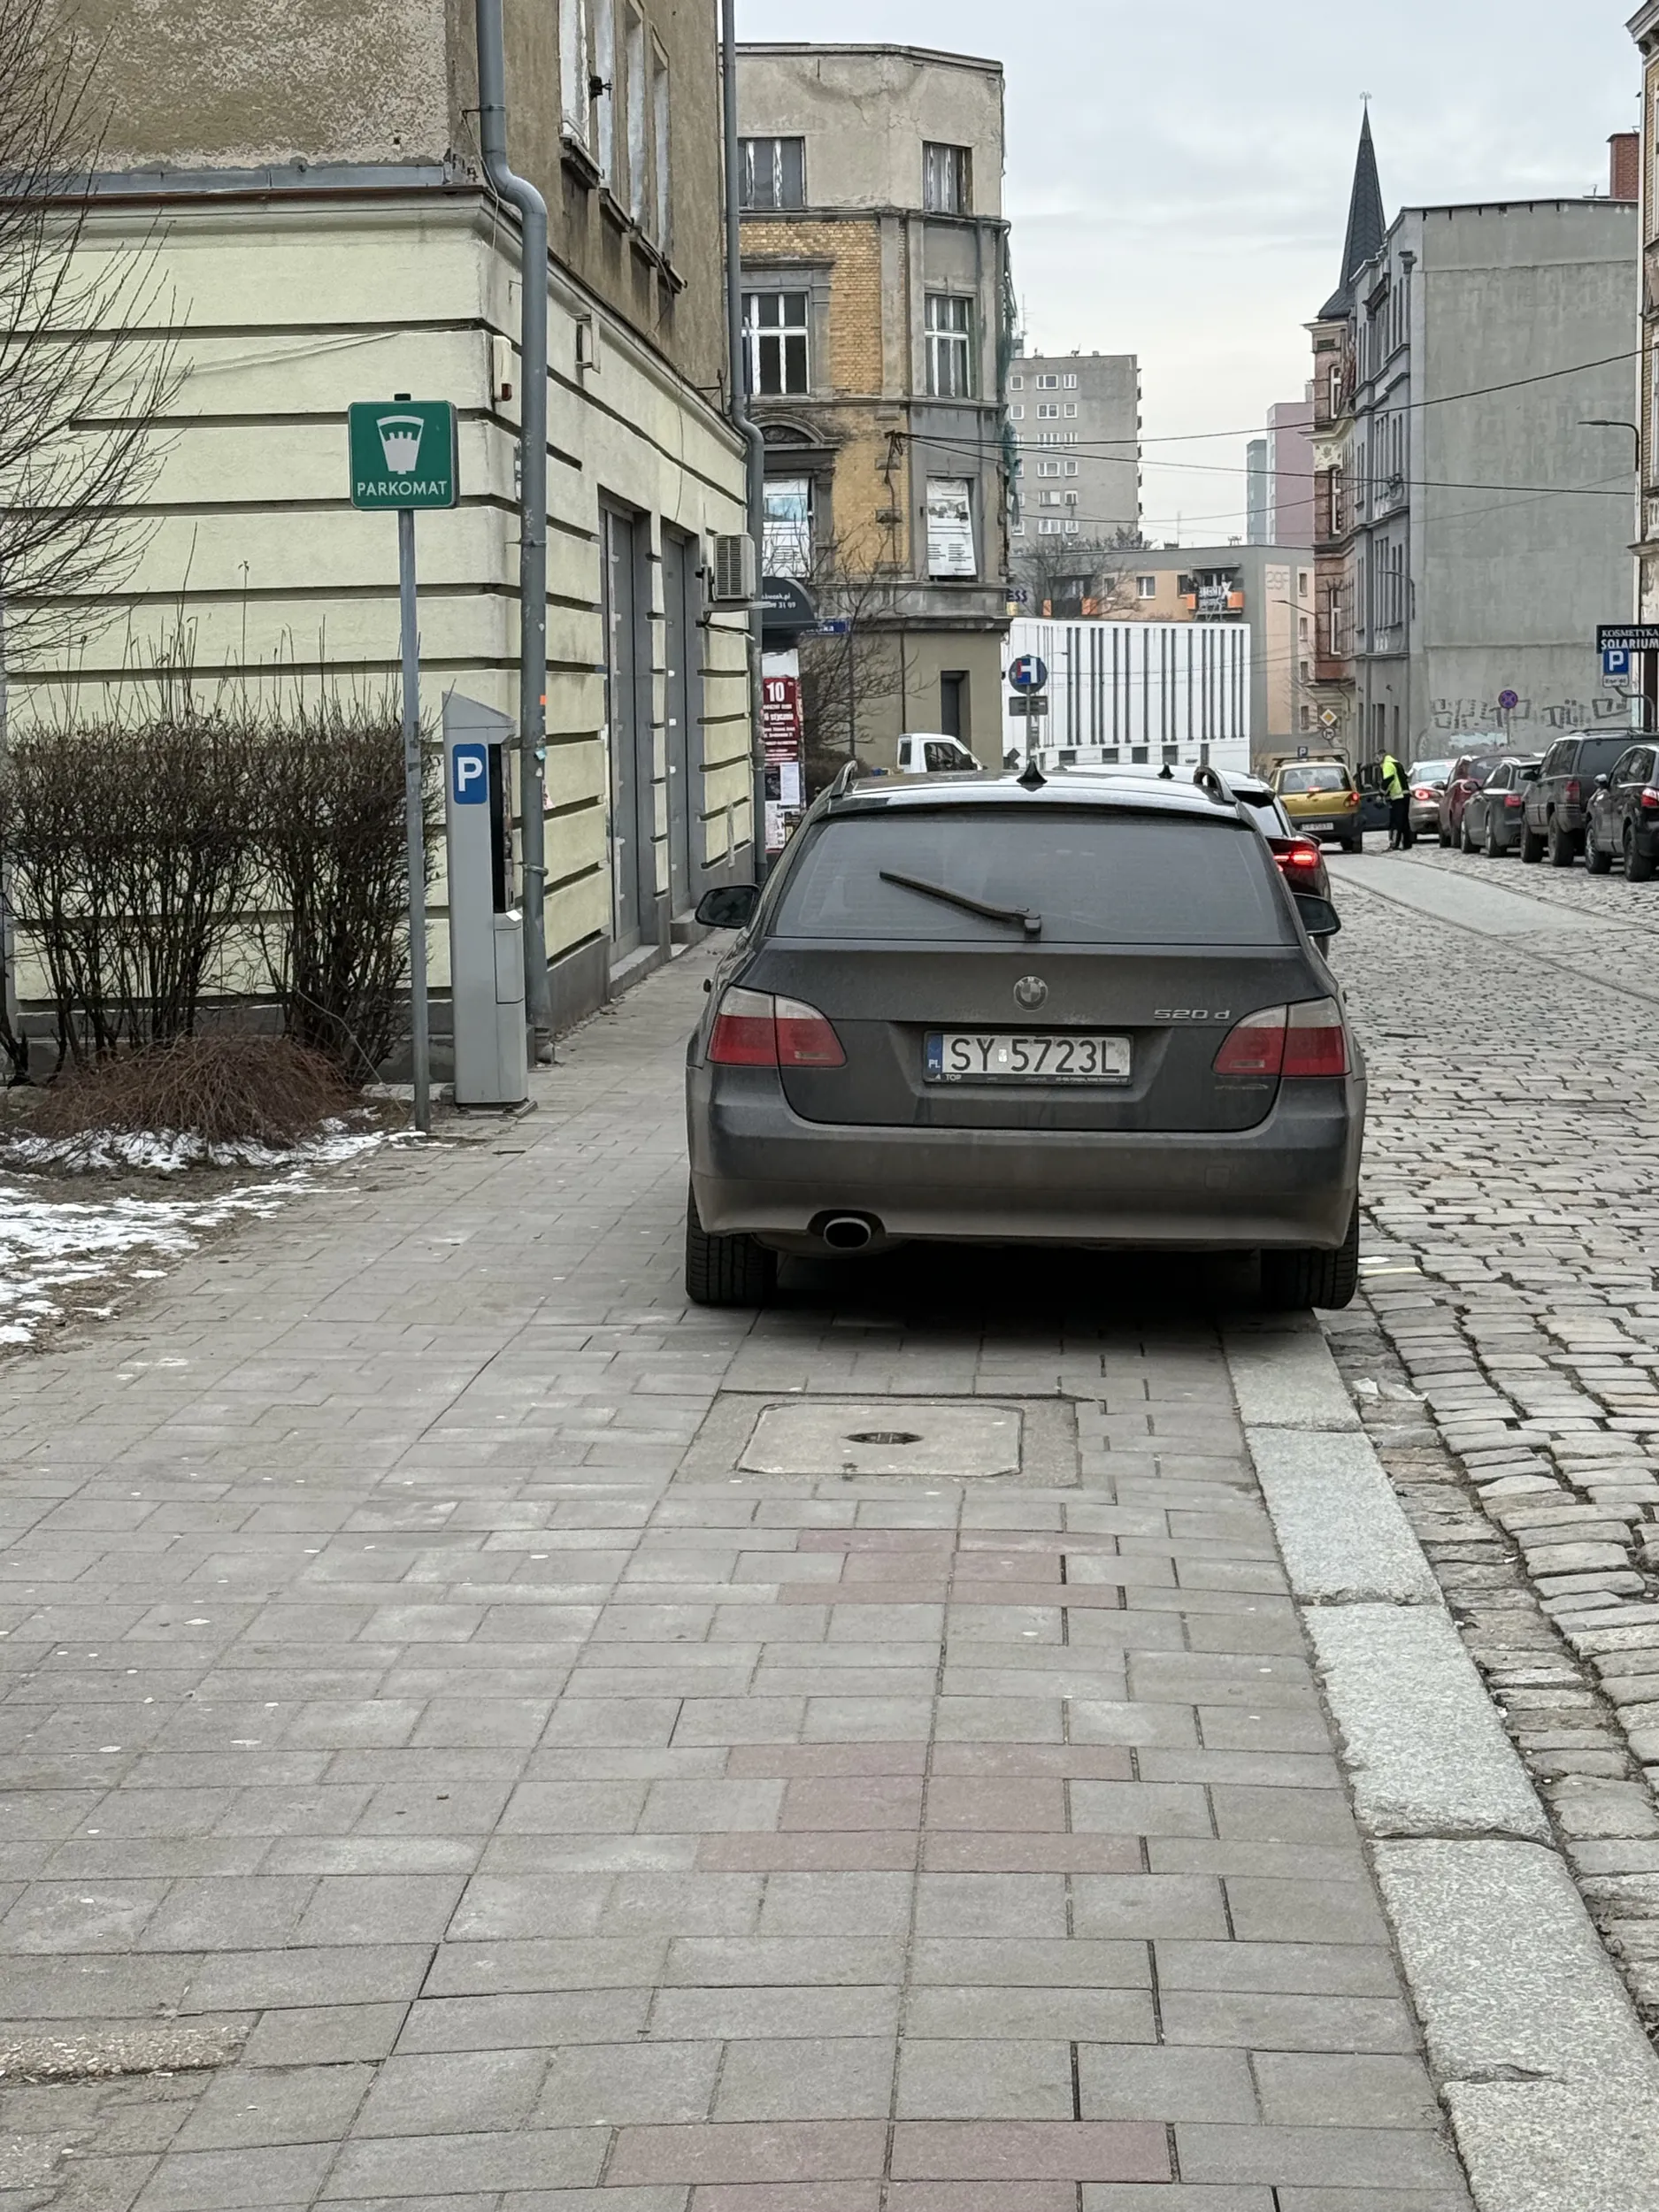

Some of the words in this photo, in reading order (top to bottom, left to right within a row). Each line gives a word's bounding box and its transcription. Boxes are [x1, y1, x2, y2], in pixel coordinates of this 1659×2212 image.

[357, 481, 448, 496] PARKOMAT
[1601, 628, 1659, 637] KOSMETYKA
[1601, 638, 1659, 650] SOLARIUM
[1609, 650, 1624, 672] P
[766, 681, 785, 703] 10
[457, 757, 483, 792] P
[1154, 1009, 1209, 1019] 520
[1214, 1010, 1231, 1019] d
[929, 1059, 941, 1069] PL
[950, 1038, 995, 1072] SY
[1010, 1039, 1121, 1073] 5723L
